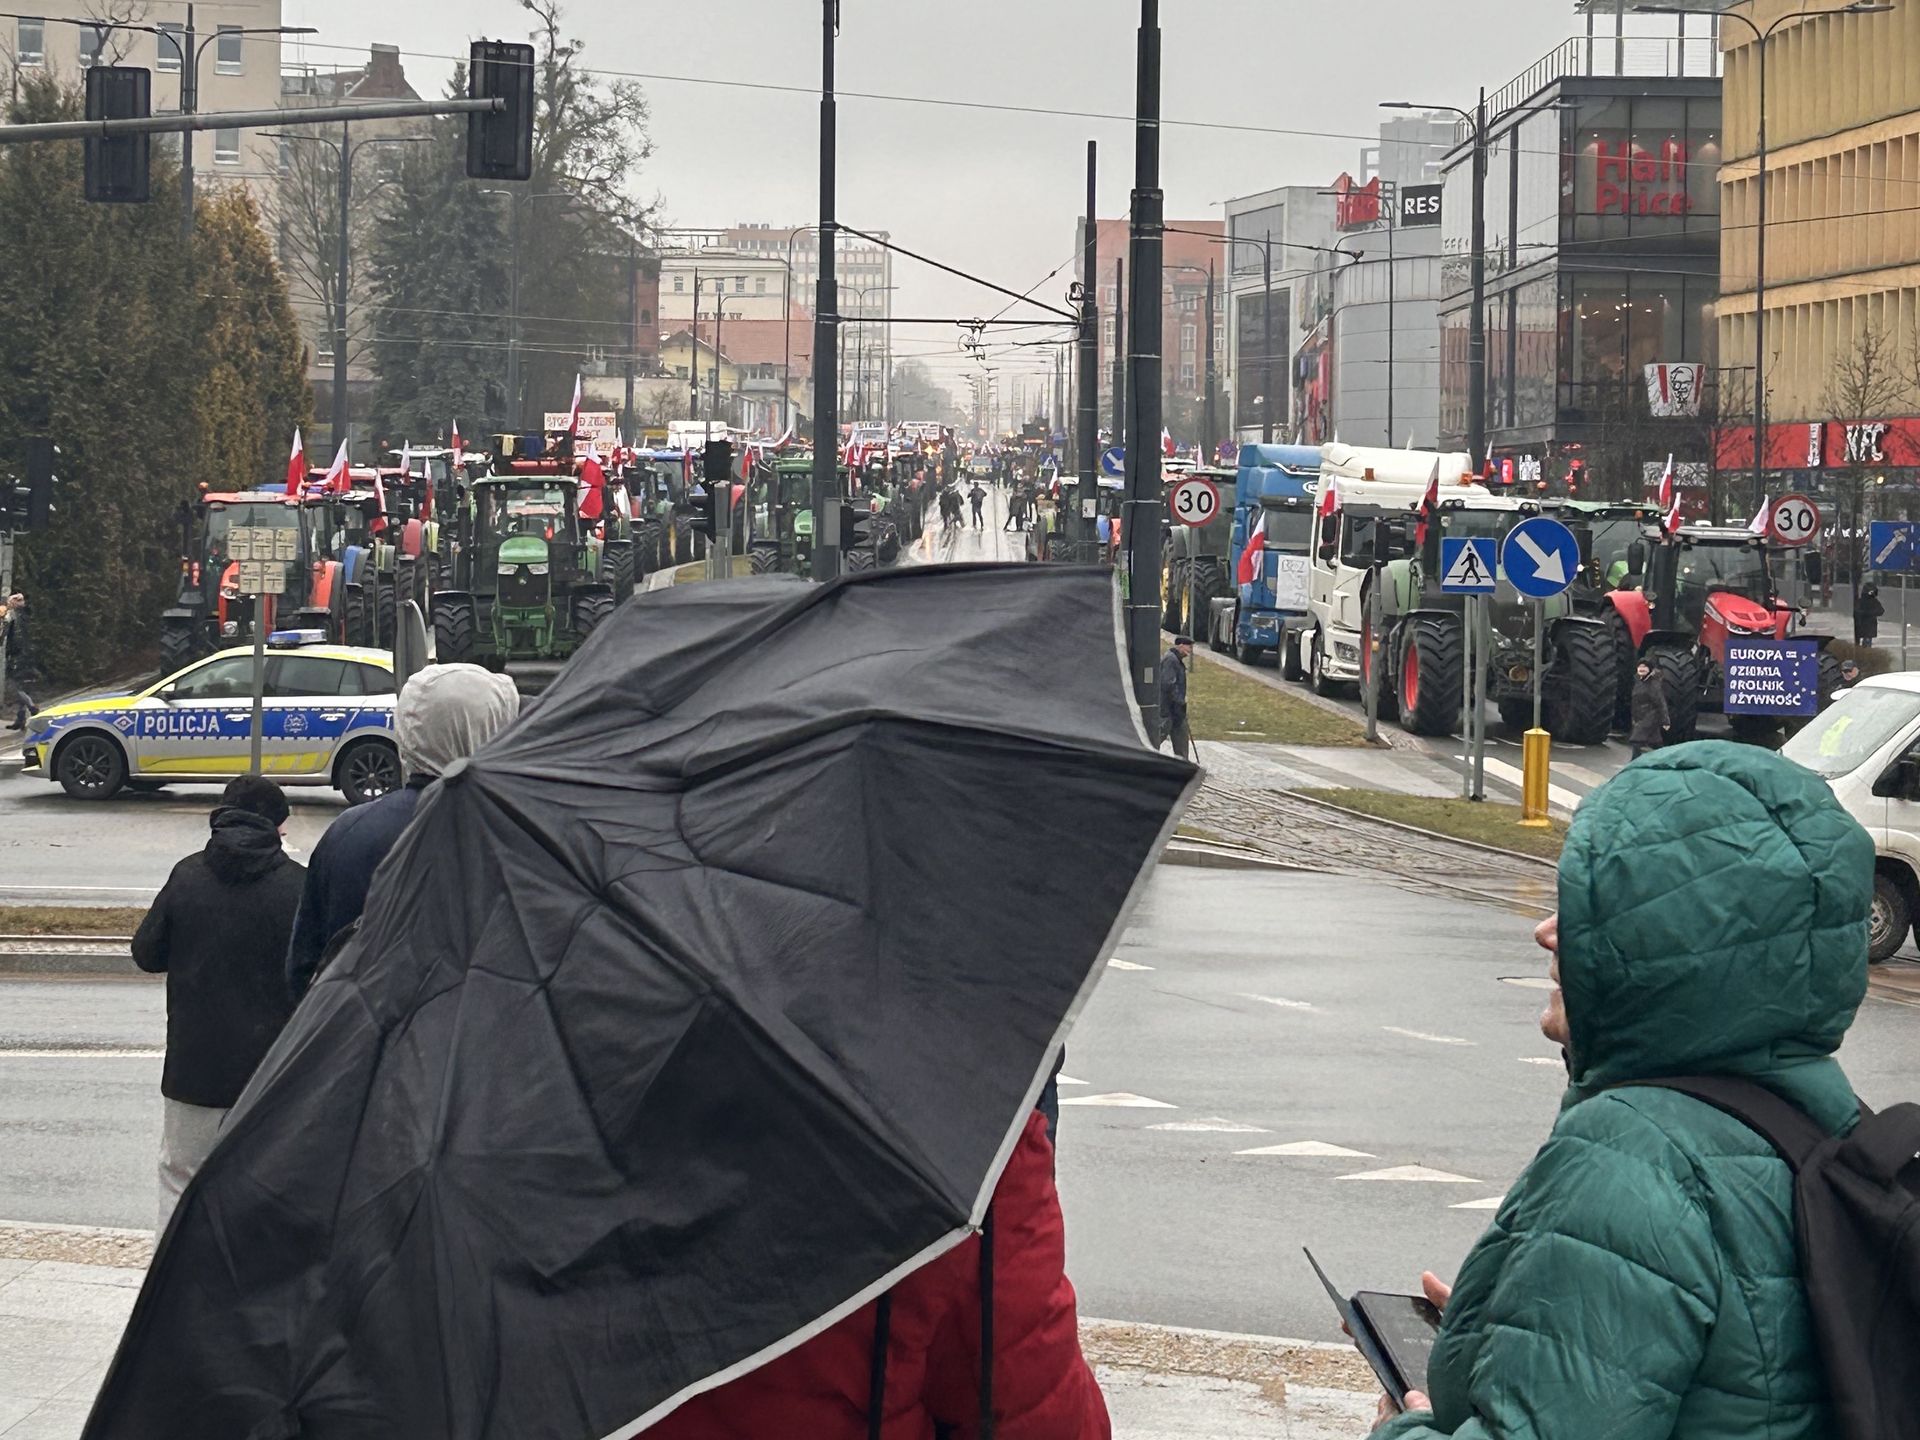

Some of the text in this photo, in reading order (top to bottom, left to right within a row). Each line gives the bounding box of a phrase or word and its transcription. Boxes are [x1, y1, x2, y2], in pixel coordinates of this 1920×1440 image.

[1404, 196, 1440, 215] RES
[1596, 182, 1695, 216] Price
[1843, 422, 1885, 462] KFC
[1177, 489, 1213, 514] 30
[1777, 507, 1814, 532] 30
[1730, 648, 1783, 661] EUROPA
[144, 715, 220, 734] POLICJA
